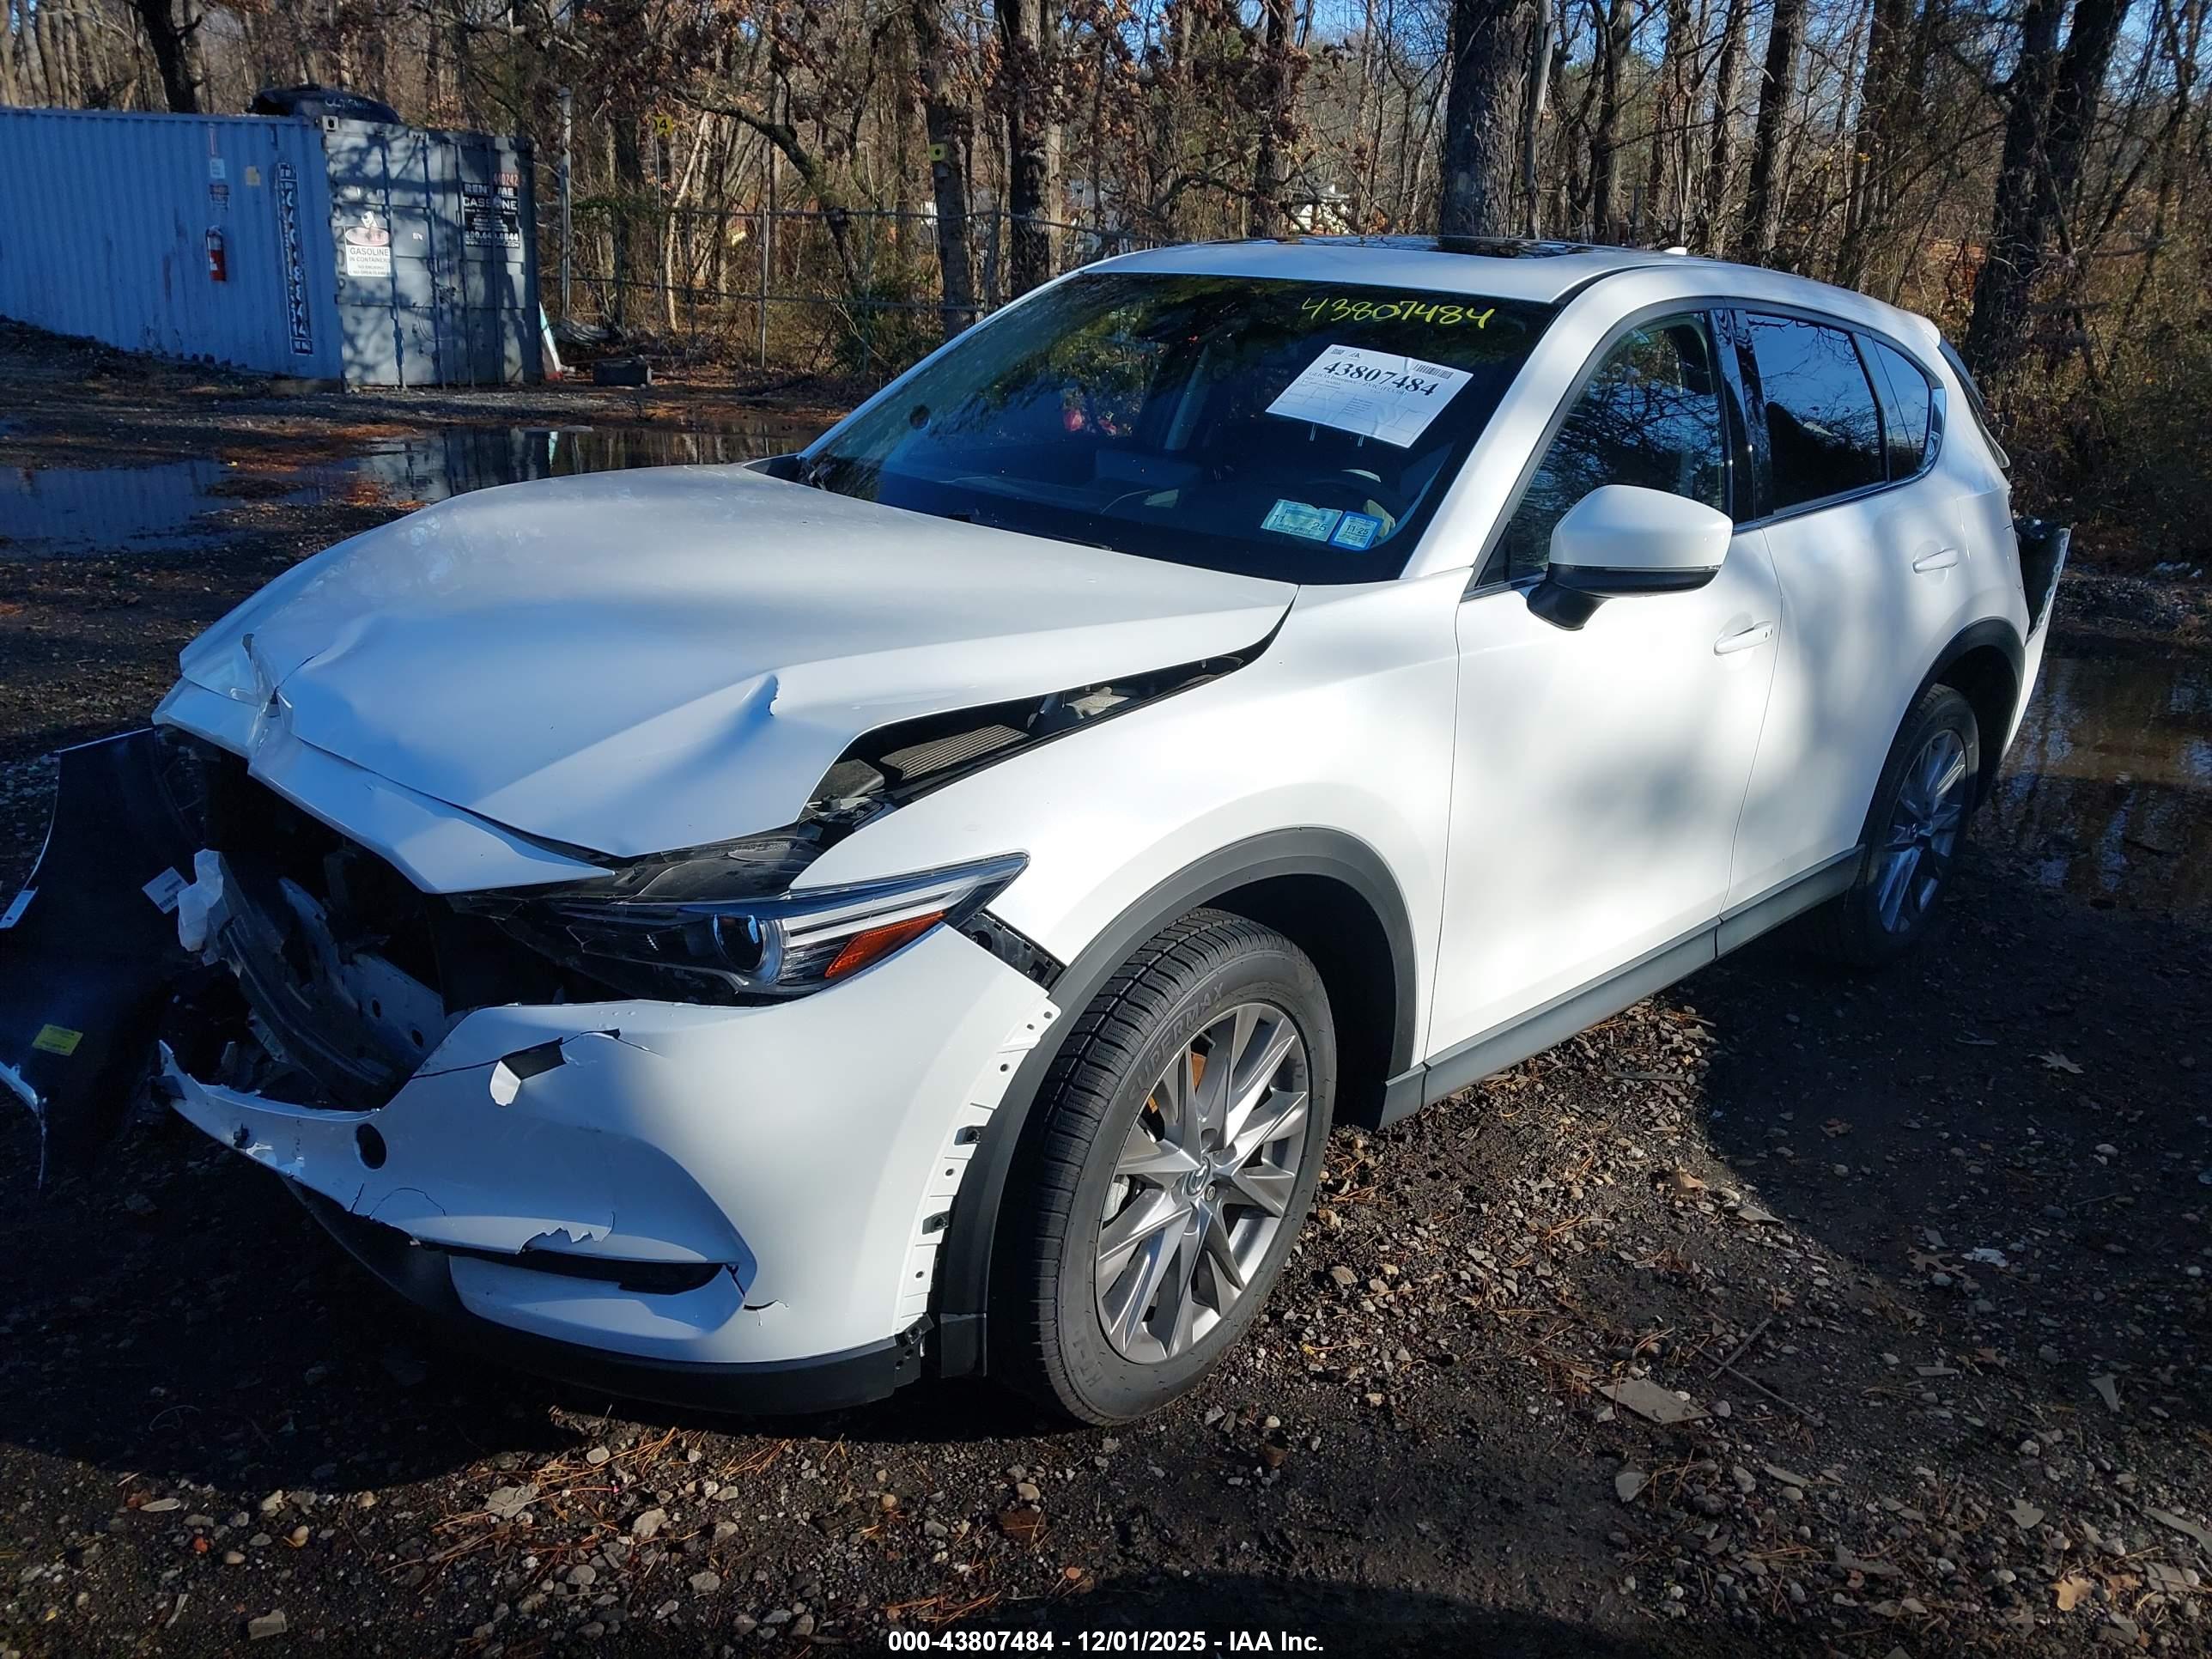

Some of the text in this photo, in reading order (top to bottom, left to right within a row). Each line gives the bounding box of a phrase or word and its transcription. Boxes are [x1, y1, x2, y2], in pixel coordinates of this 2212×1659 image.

[465, 184, 489, 193] REN
[463, 197, 517, 210] CASSNE
[349, 247, 389, 257] GASOLINE
[1301, 297, 1495, 329] 43807484
[1323, 361, 1440, 397] 43807484
[1273, 514, 1285, 524] 11
[1310, 521, 1327, 532] 25
[1127, 981, 1224, 1101] SUPERMAX
